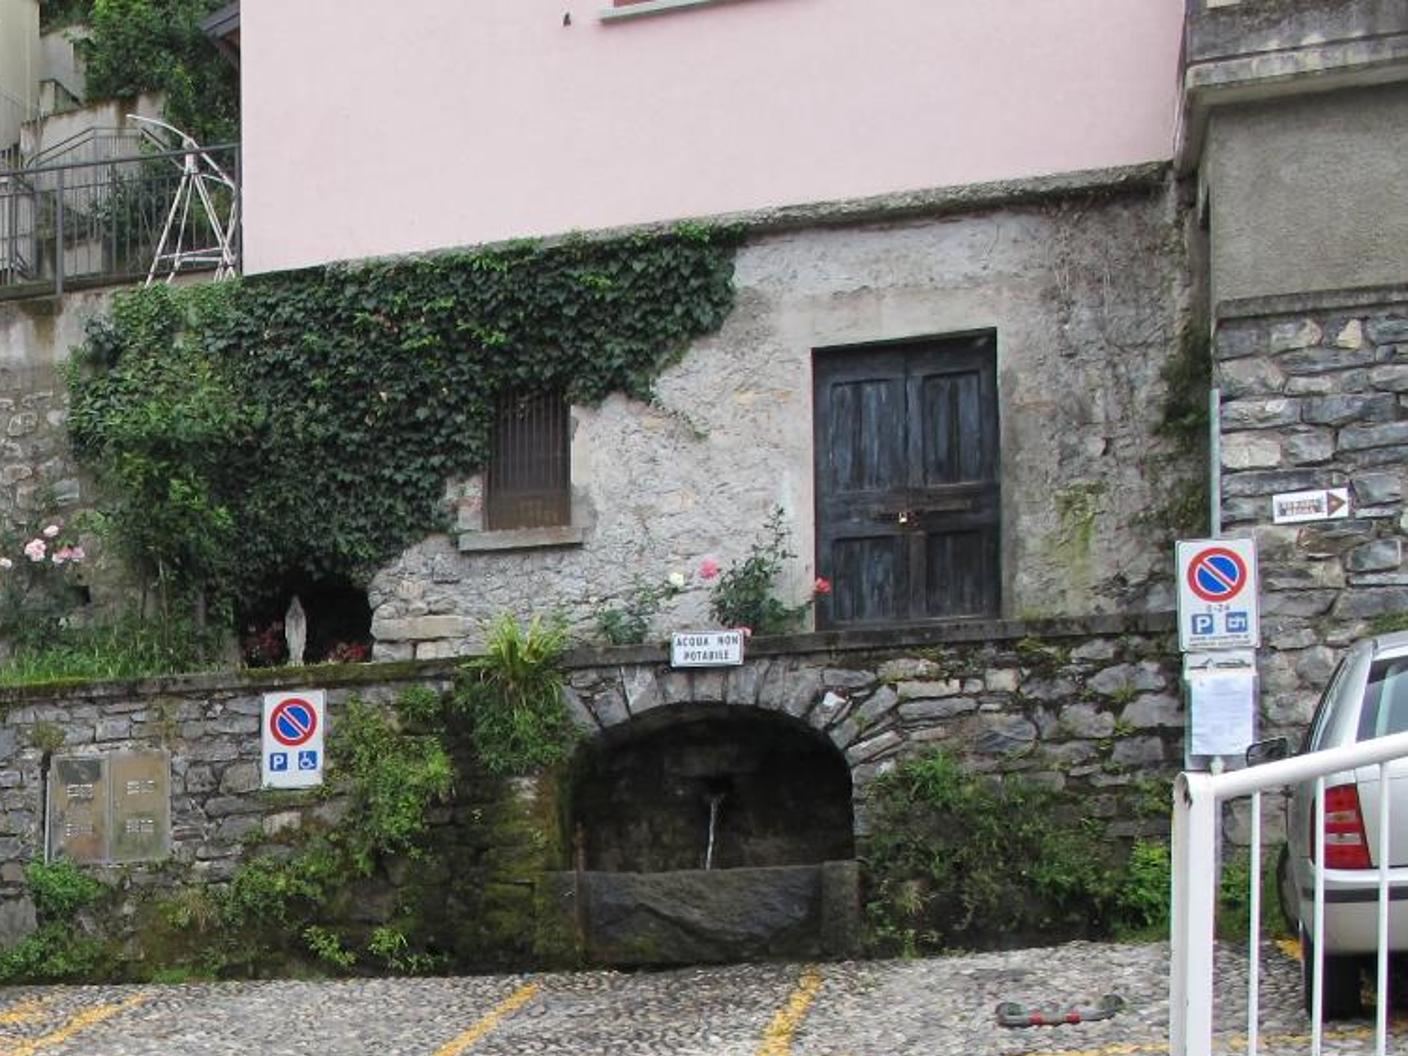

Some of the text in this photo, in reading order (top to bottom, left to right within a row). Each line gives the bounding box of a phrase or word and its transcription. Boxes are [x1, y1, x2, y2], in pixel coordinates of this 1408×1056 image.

[1196, 616, 1211, 633] P
[677, 634, 739, 647] ACQUA NON
[683, 649, 730, 661] POTABILE
[273, 754, 285, 770] P
